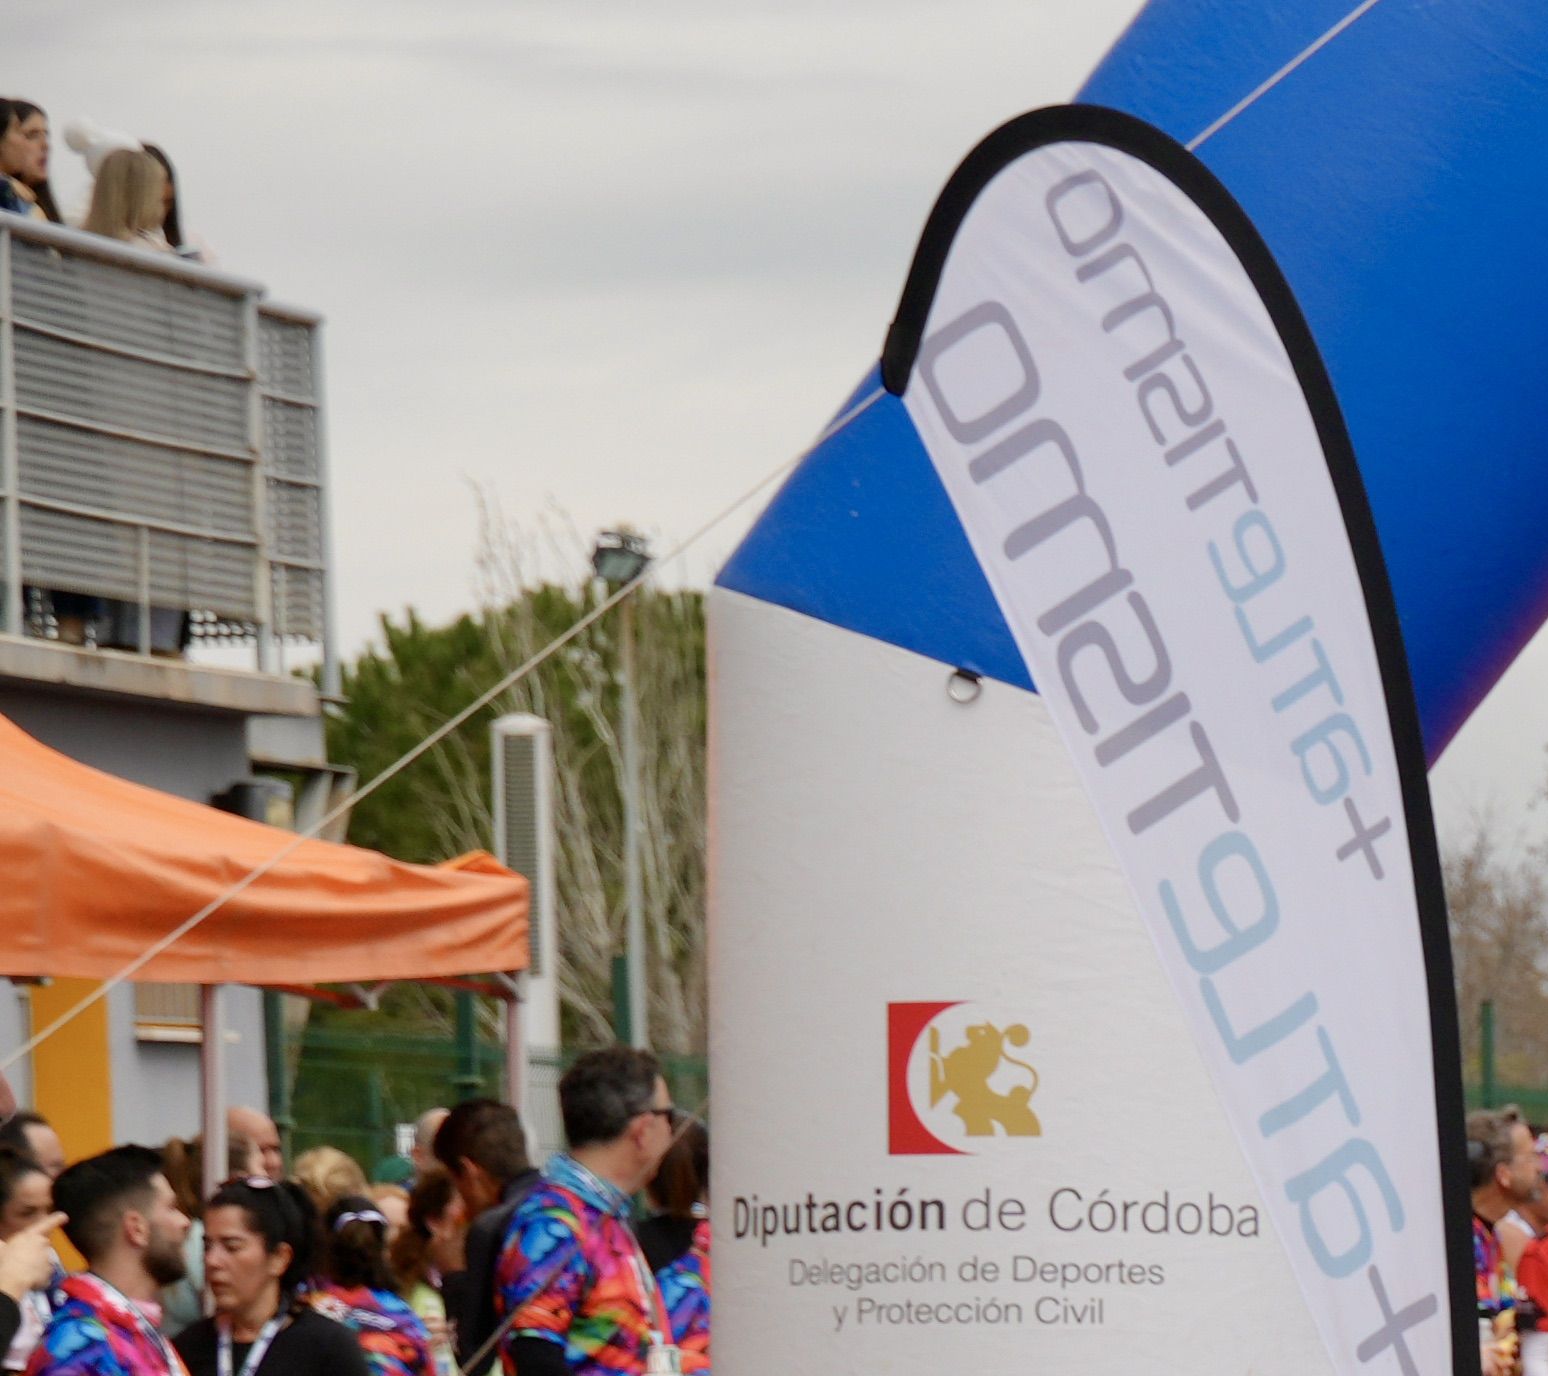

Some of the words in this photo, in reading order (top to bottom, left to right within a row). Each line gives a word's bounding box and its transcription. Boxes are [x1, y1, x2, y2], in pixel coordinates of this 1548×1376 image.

[733, 1187, 946, 1248] Diputación
[962, 1187, 1027, 1232] de
[1049, 1187, 1260, 1238] Córdoba
[788, 1257, 946, 1290] Delegación
[959, 1257, 999, 1282] de
[1012, 1255, 1165, 1289] Deportes
[832, 1304, 848, 1332] y
[856, 1297, 1022, 1326] Protección
[1035, 1296, 1104, 1326] Civil
